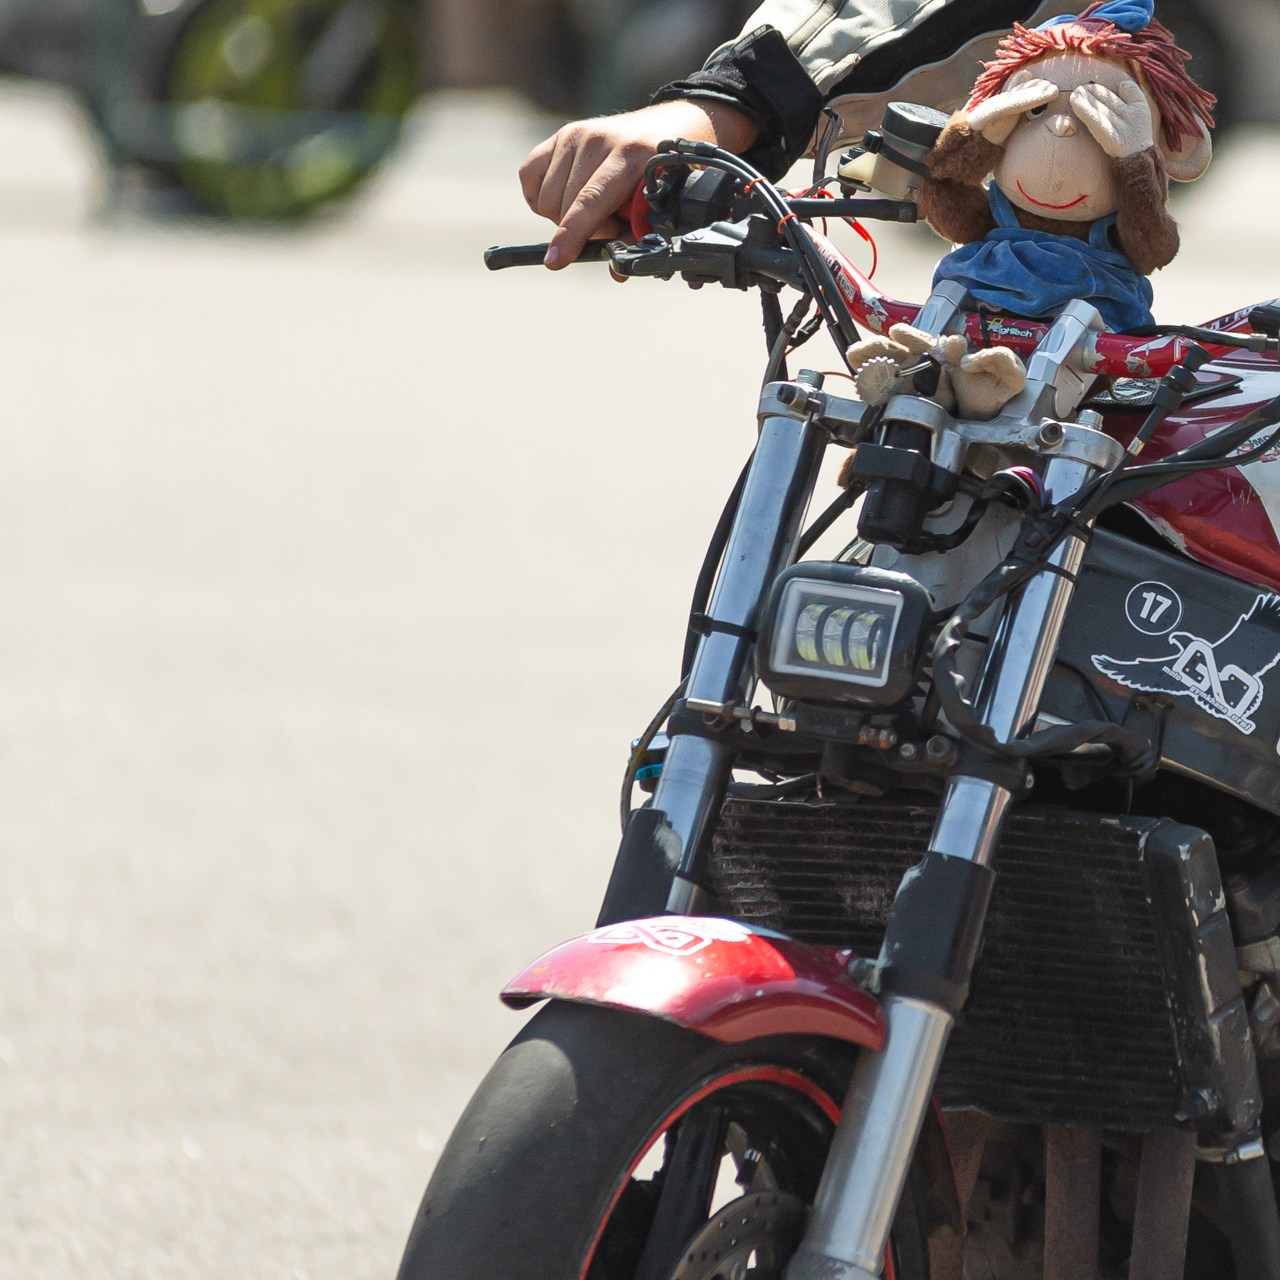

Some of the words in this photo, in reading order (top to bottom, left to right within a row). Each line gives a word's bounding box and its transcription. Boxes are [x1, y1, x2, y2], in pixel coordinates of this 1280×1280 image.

[1140, 592, 1172, 624] 17
[1162, 666, 1183, 681] moto
[1189, 685, 1229, 715] gymkhana
[1230, 714, 1253, 732] orel
